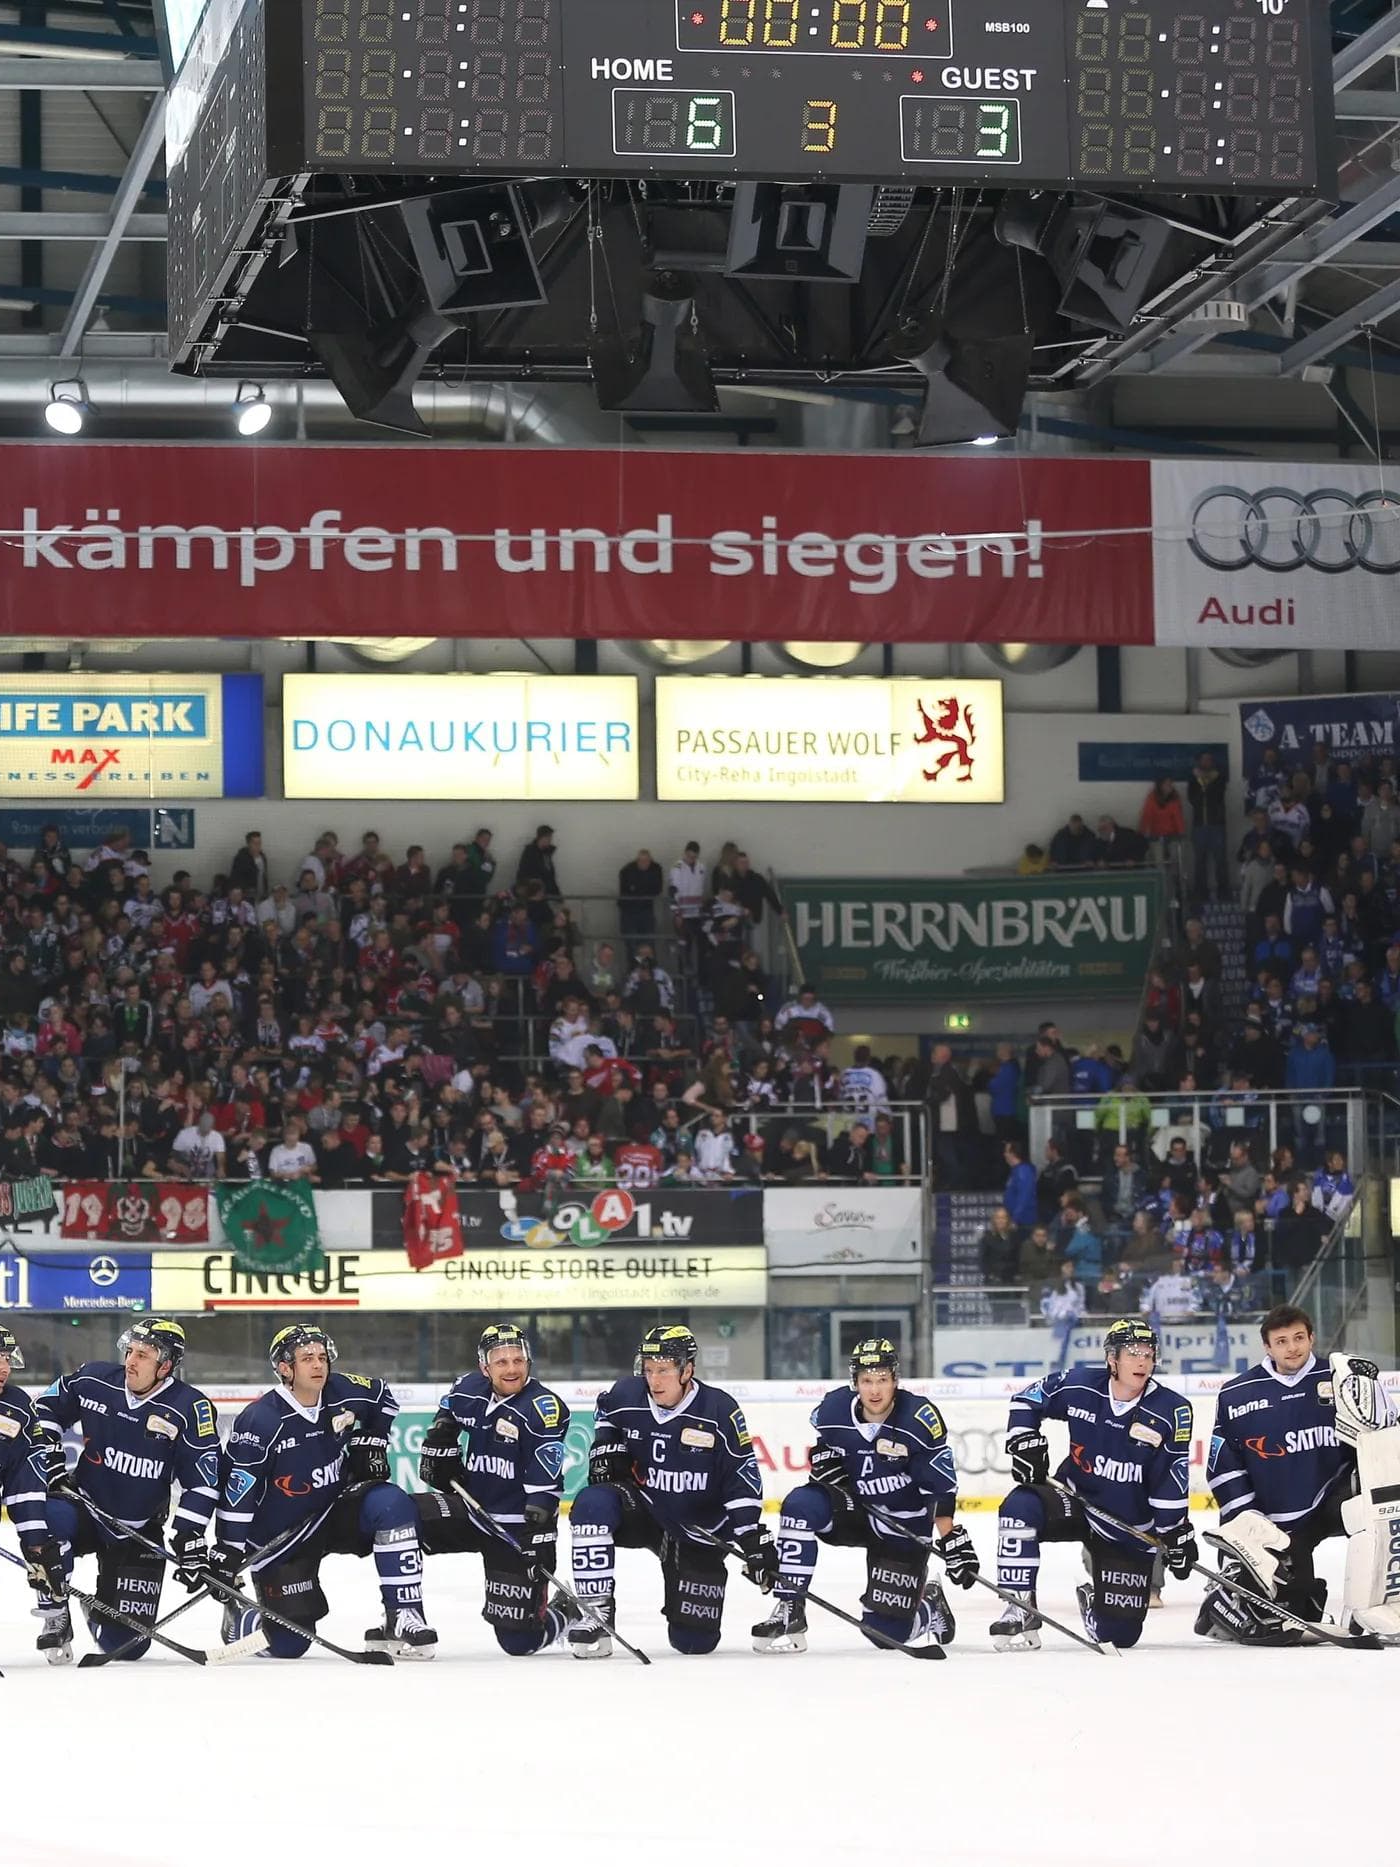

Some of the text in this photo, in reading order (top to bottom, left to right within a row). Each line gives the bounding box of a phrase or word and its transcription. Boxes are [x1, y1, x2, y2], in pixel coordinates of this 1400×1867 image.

[984, 22, 1030, 35] MSB100
[590, 57, 674, 82] HOME
[940, 66, 1038, 92] GUEST
[686, 97, 723, 151] 6
[803, 99, 837, 153] 3
[975, 103, 1009, 157] 3
[22, 507, 458, 587] kämpfen
[493, 513, 674, 575] und
[708, 515, 1045, 596] siegen!
[1198, 597, 1297, 628] Audi
[71, 702, 195, 733] PARK
[291, 718, 633, 753] DONAUKURIER
[675, 729, 902, 756] PASSAUER WOLF
[50, 748, 121, 776] MAX
[675, 765, 762, 785] City-Reha
[794, 895, 1149, 952] HERRNBRÄU
[444, 1257, 713, 1281] CINQUE STORE OUTLET
[1228, 1399, 1274, 1420] hama
[652, 1438, 667, 1464] C
[1285, 1426, 1339, 1454] SATUR
[646, 1466, 708, 1492] SATURN
[572, 1546, 609, 1569] 55
[116, 1577, 161, 1595] HERRN
[281, 1579, 313, 1597] SATURN
[485, 1579, 533, 1599] HERRN
[677, 1579, 724, 1599] HERRN
[871, 1567, 919, 1589] HERRN
[1101, 1569, 1148, 1588] HERRN
[118, 1599, 156, 1616] BRÄU
[486, 1602, 526, 1621] BRÄU
[680, 1601, 719, 1620] BRÄU
[872, 1589, 912, 1610] BRÄU
[1104, 1591, 1144, 1609] BRÄU
